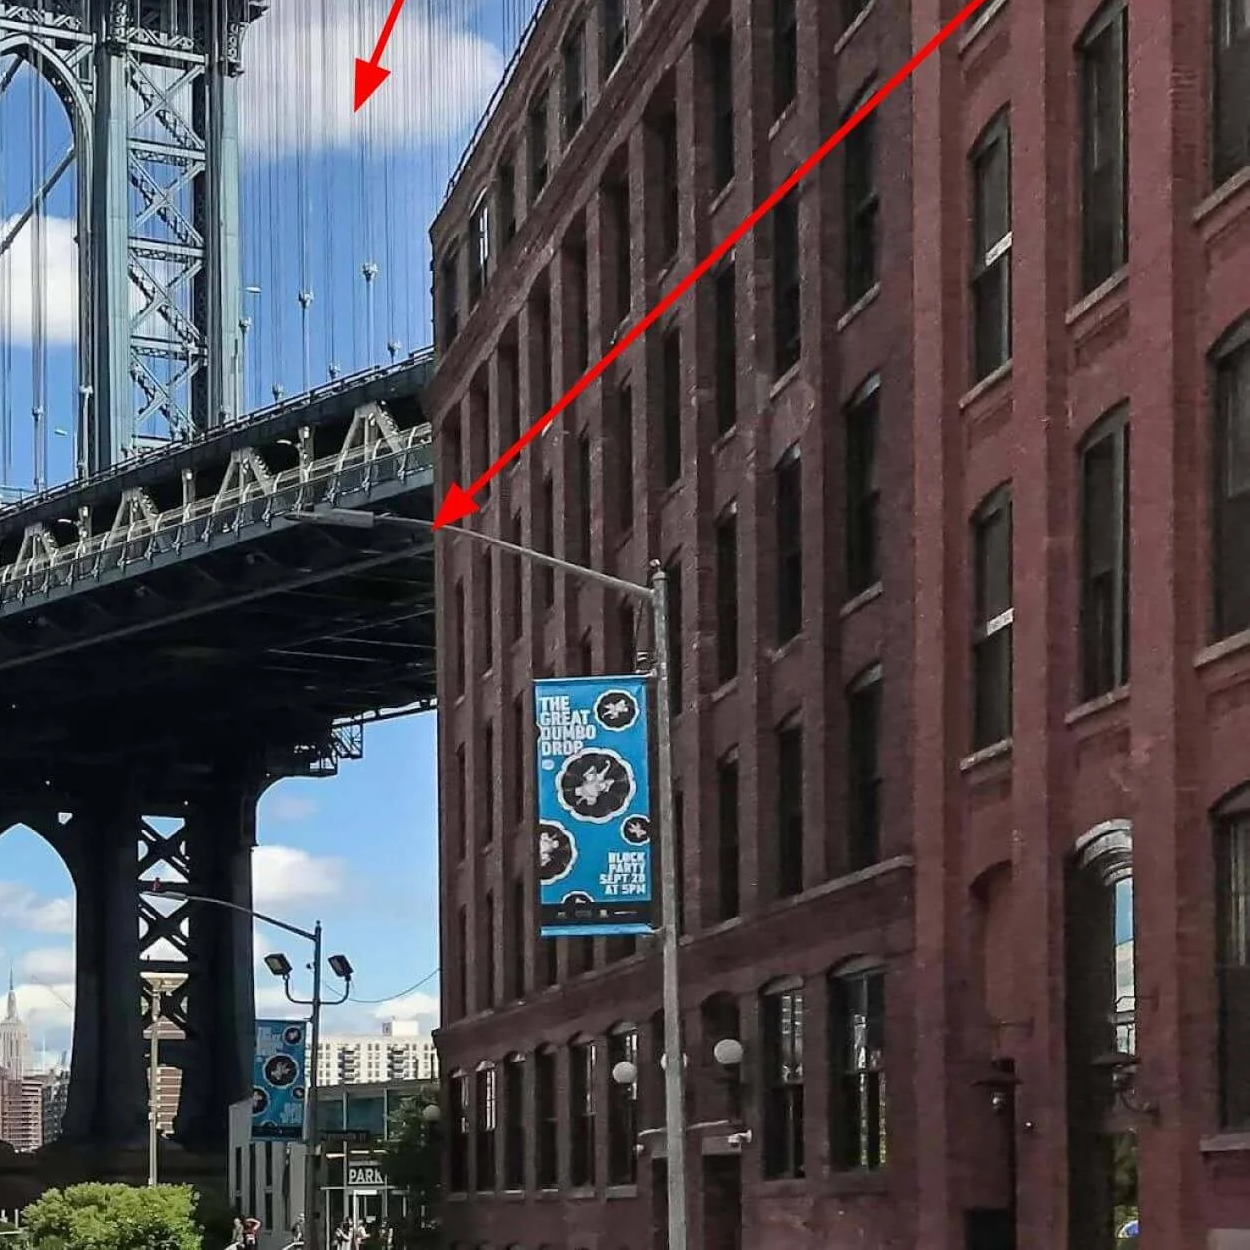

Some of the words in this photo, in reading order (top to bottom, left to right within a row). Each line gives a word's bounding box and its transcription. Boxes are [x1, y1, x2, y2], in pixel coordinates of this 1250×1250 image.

[539, 696, 570, 711] THE
[540, 710, 590, 725] GREAT
[541, 725, 596, 740] DUMBO
[541, 741, 583, 755] DROP
[608, 852, 645, 863] BLOCK
[609, 862, 646, 873] PARTY
[599, 873, 630, 884] SEPT
[605, 884, 618, 895] AT
[622, 884, 646, 894] 5PM
[348, 1168, 384, 1183] PARK
